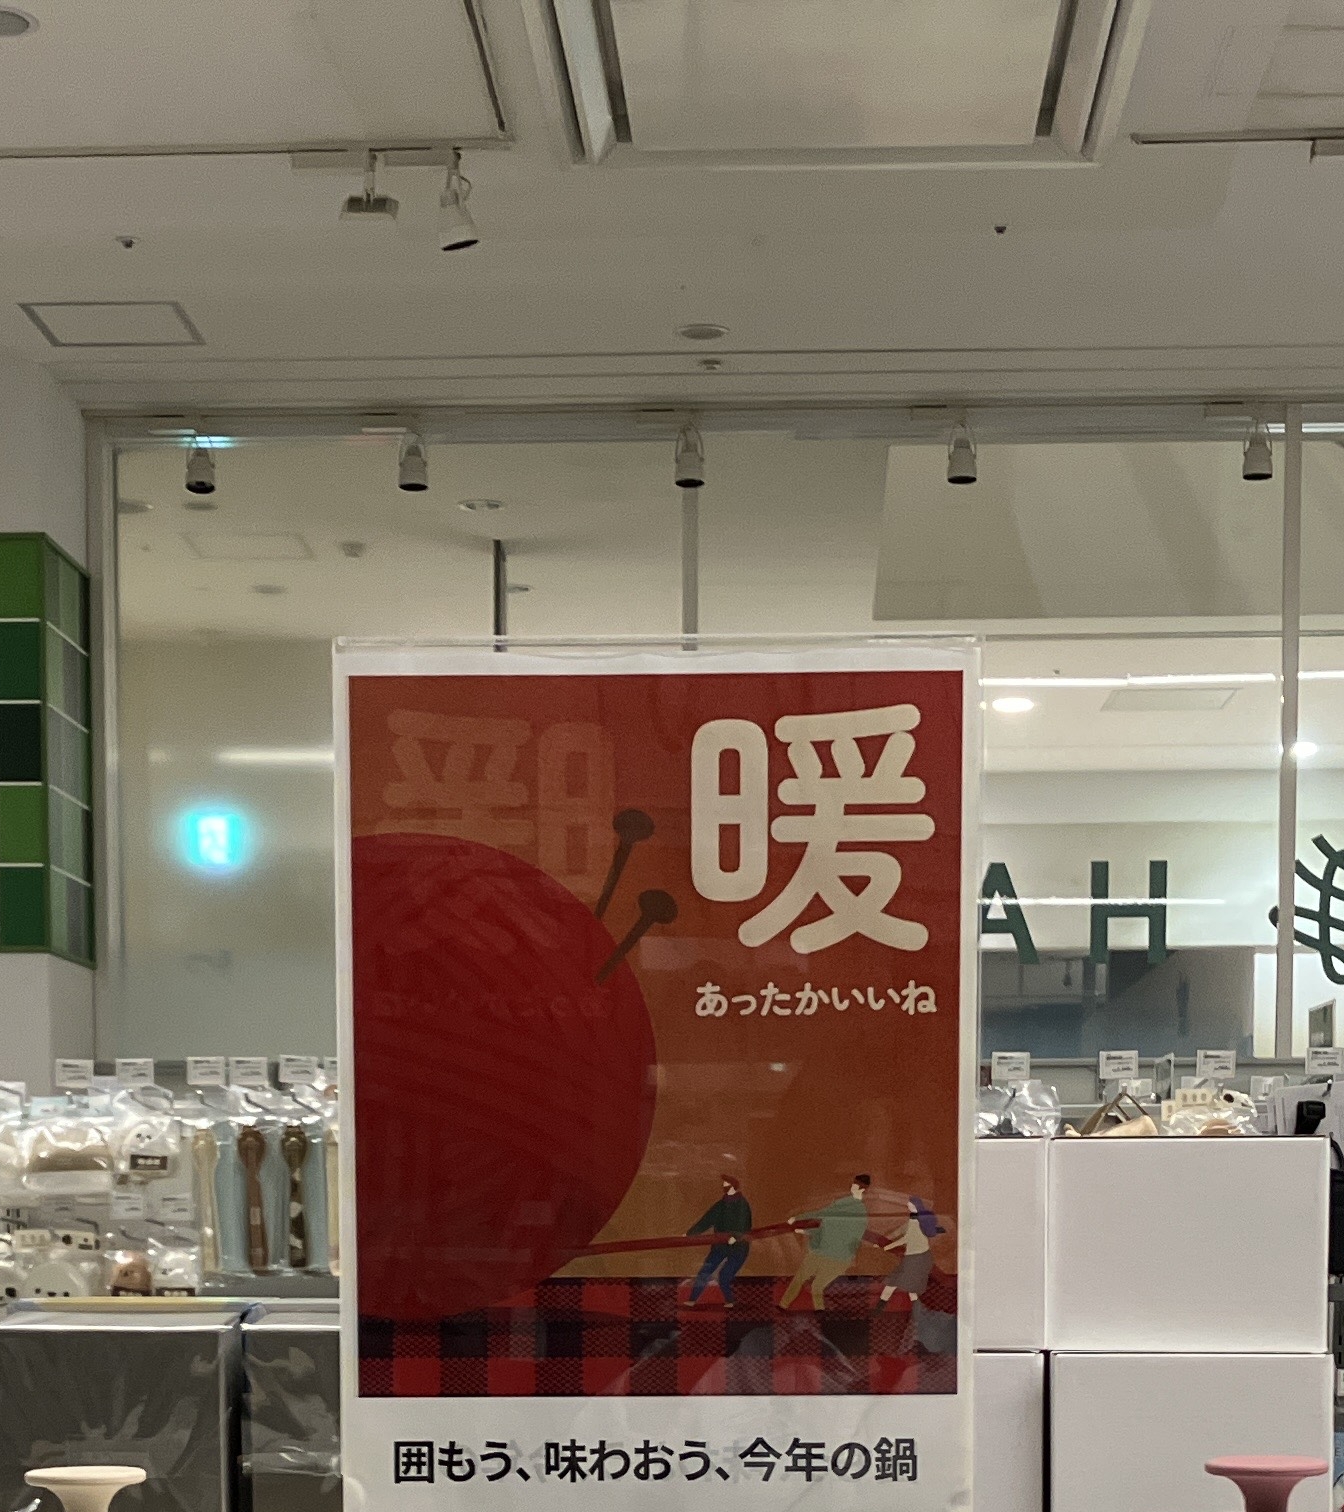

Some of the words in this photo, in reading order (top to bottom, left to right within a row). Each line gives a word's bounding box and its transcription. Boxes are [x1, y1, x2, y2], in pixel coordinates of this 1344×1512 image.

[691, 703, 935, 954] 暖
[695, 981, 937, 1017] あったかいいね
[394, 1437, 918, 1483] 囲もう、味わおう、今年の鍋
